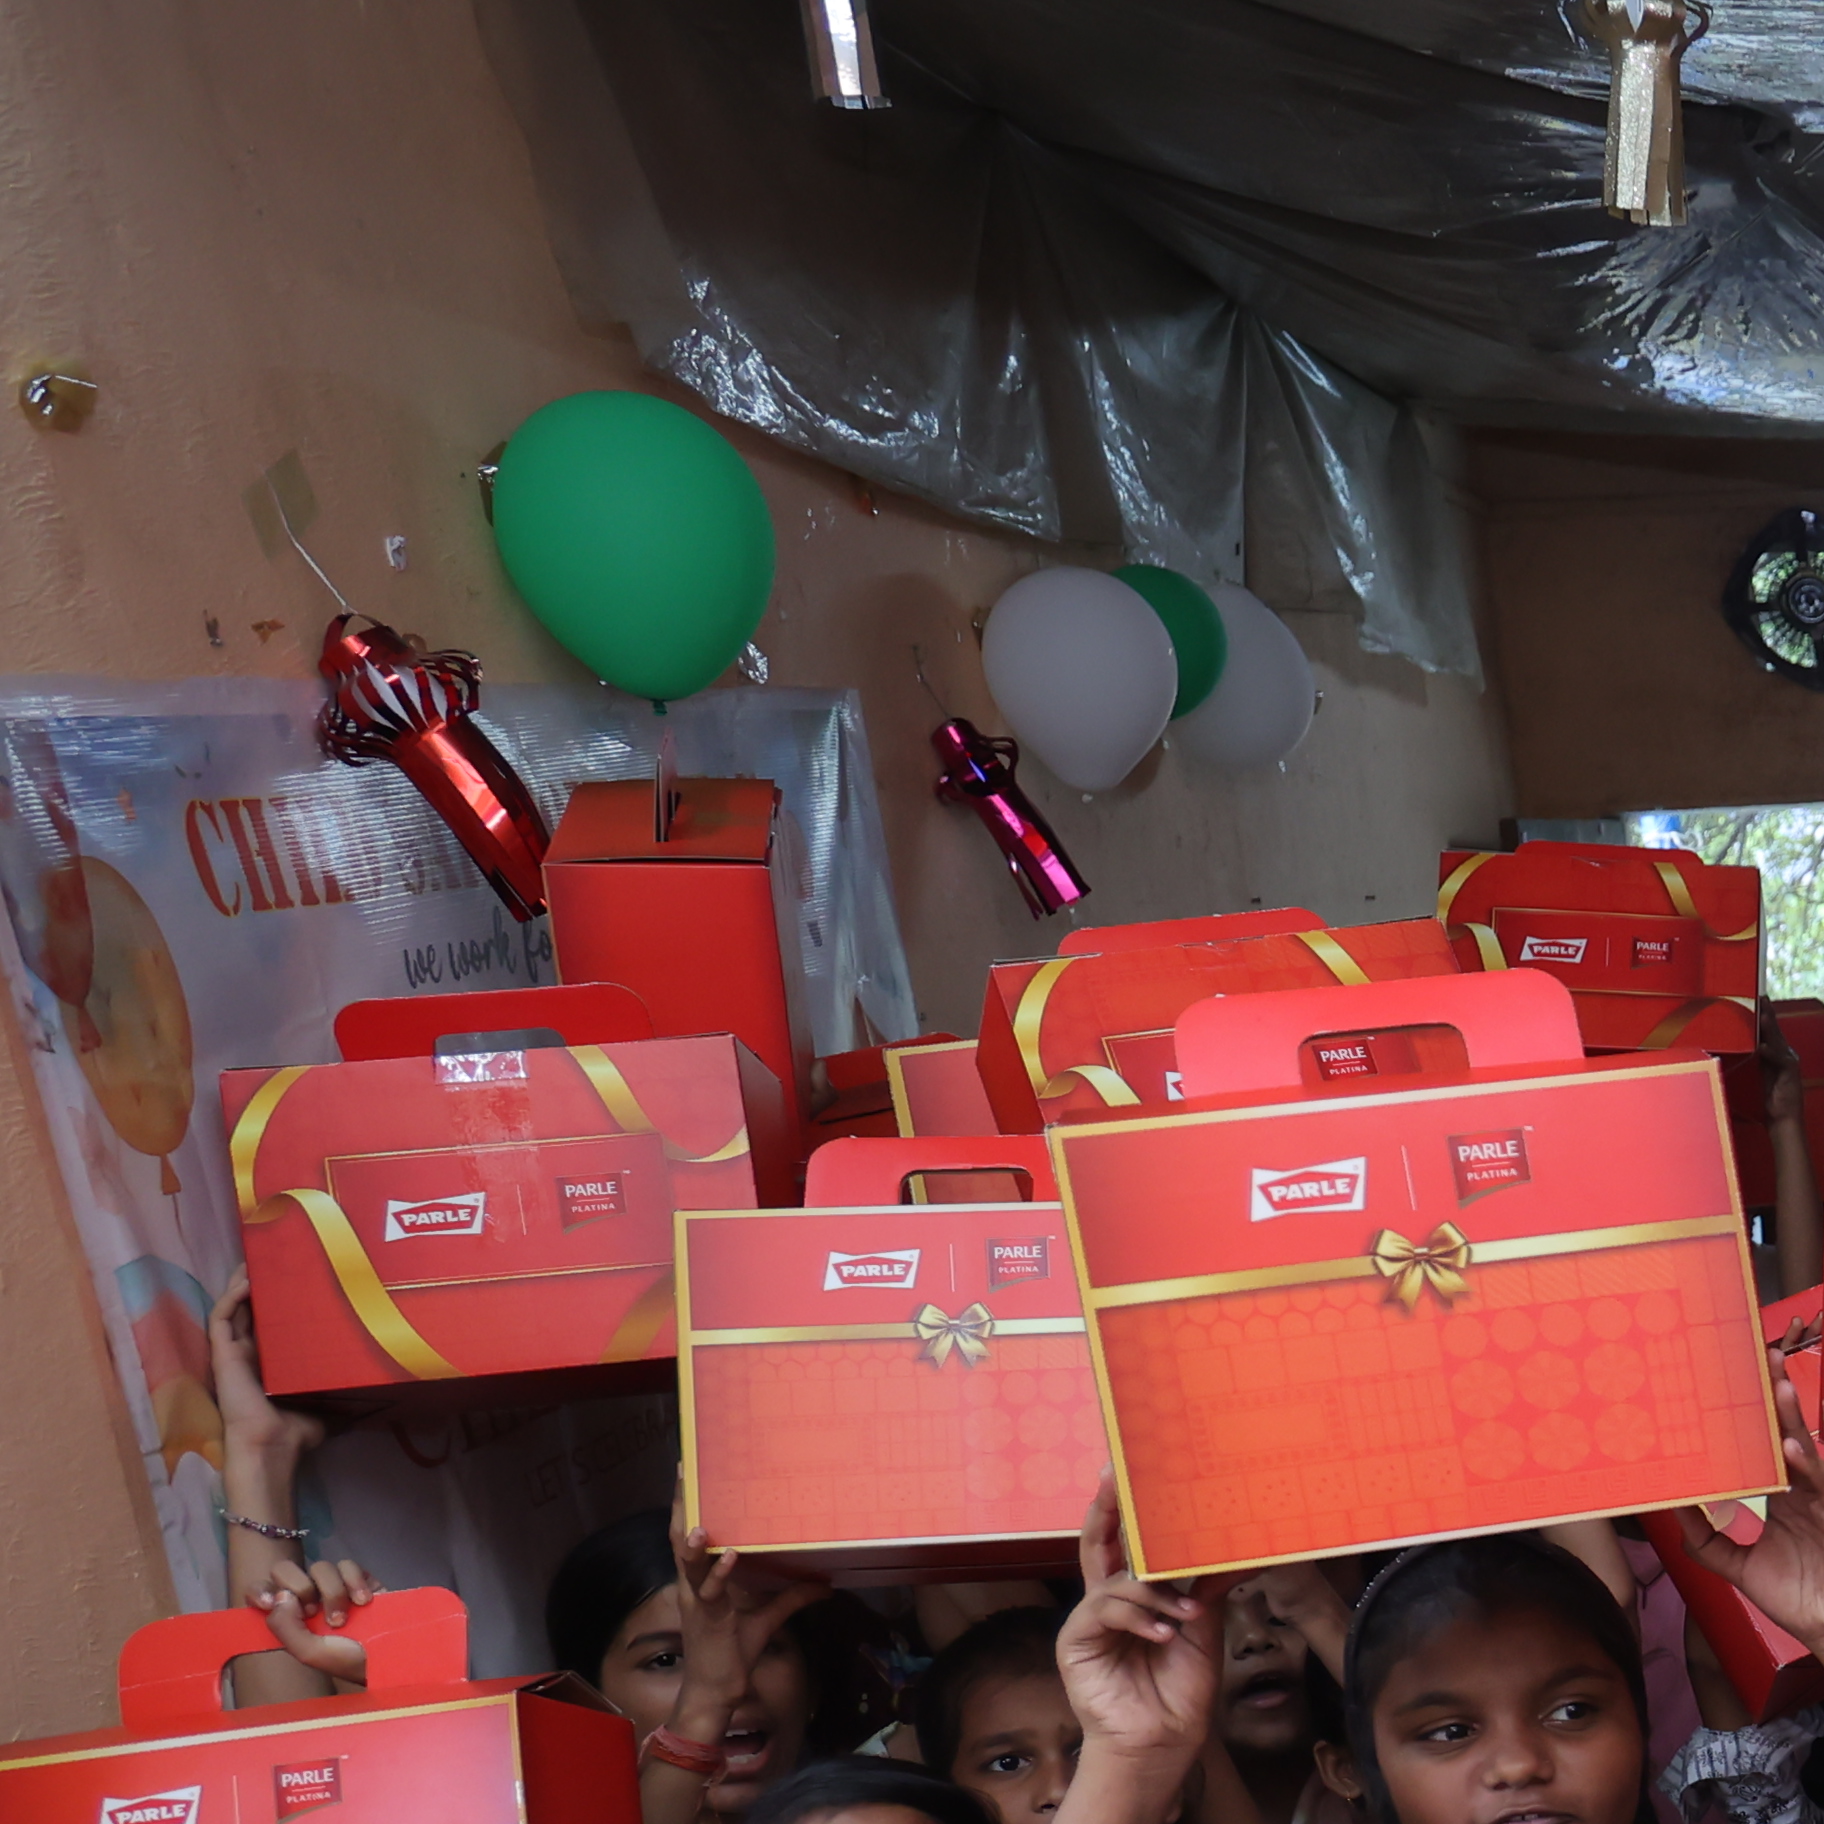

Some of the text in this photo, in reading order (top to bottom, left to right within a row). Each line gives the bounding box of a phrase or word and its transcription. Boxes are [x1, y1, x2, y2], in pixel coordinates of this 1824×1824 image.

[405, 941, 442, 989] we
[449, 906, 517, 981] work
[1532, 944, 1576, 955] PARLE
[1636, 941, 1669, 952] PARLE
[1319, 1046, 1367, 1062] PARLE
[1329, 1064, 1368, 1075] PLATINA
[1457, 1140, 1519, 1162] PARLE
[1467, 1168, 1518, 1181] PLATINA
[564, 1181, 618, 1198] PARLE
[1267, 1177, 1351, 1202] PARLE
[571, 1202, 616, 1213] PLATINA
[400, 1208, 471, 1226] PARLE
[993, 1245, 1042, 1259] PARLE
[840, 1263, 907, 1277] PARLE
[998, 1265, 1039, 1274] PLATINA
[281, 1768, 334, 1787] PARLE
[286, 1792, 332, 1804] PLATINA
